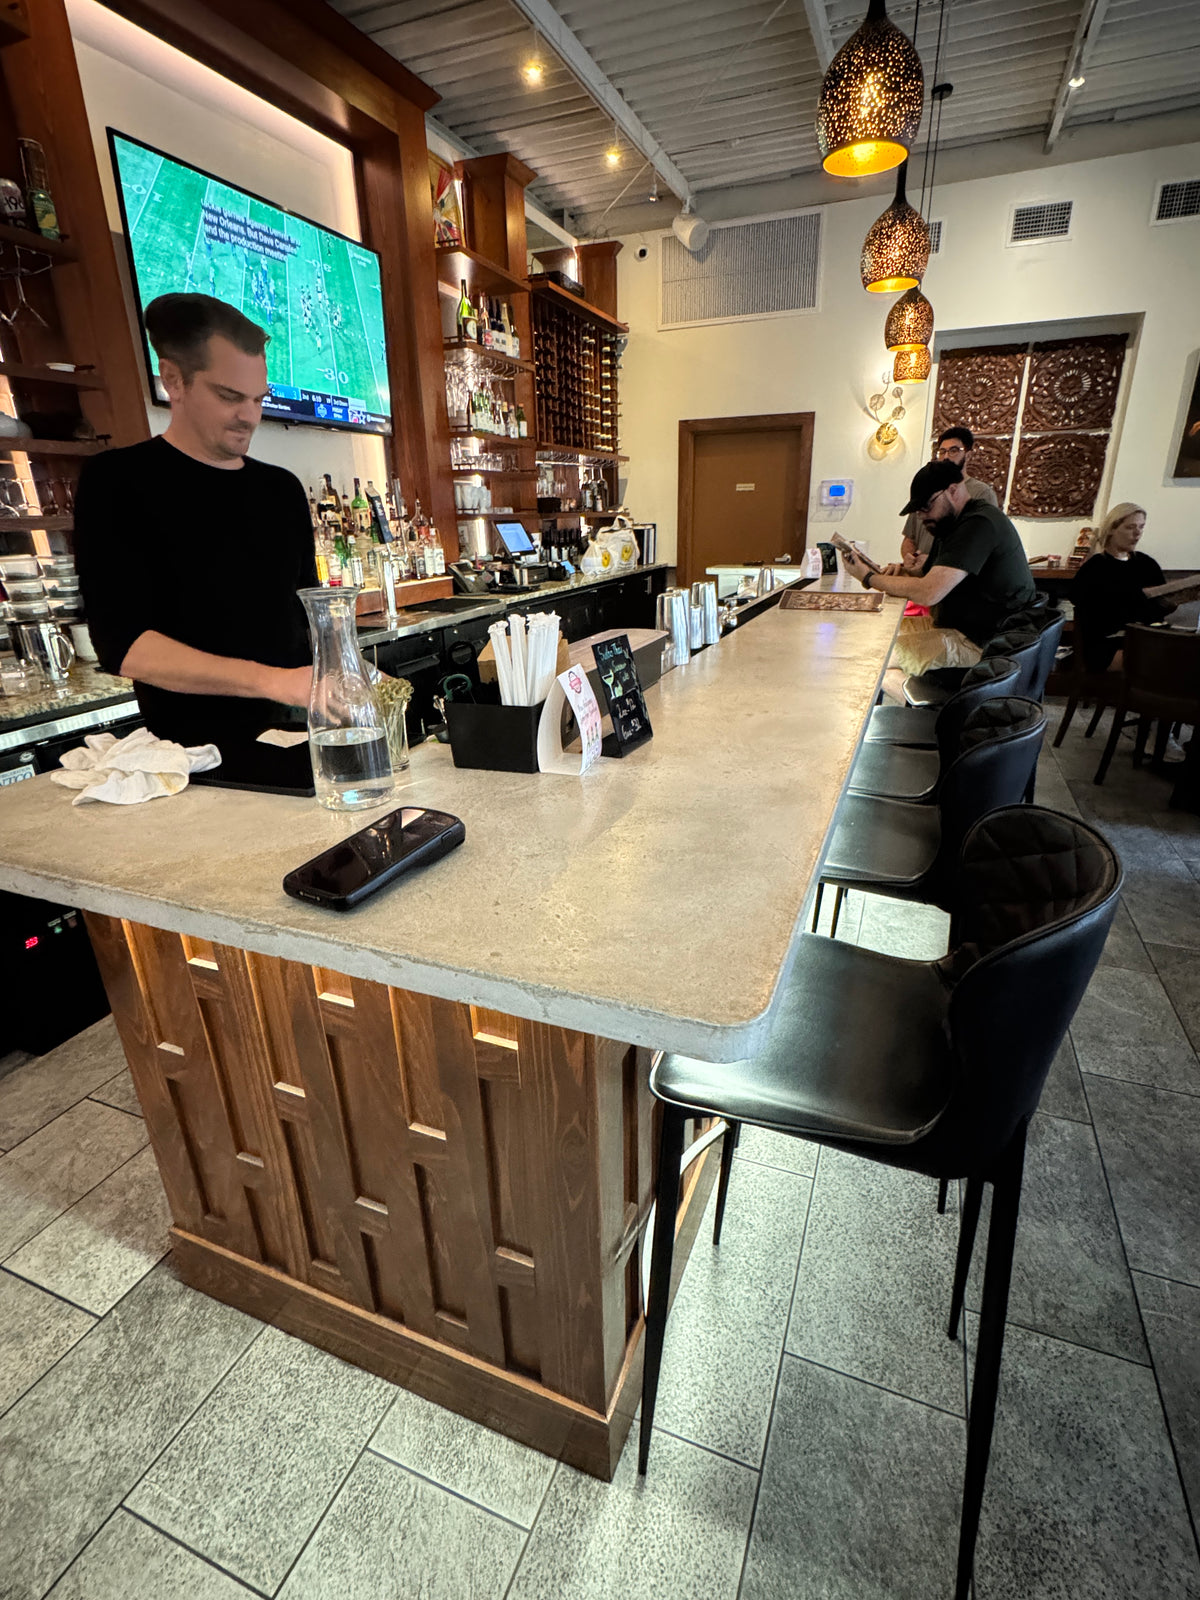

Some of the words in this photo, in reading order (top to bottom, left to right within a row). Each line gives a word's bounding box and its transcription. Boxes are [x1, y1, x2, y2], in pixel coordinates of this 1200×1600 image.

[204, 223, 218, 237] and
[230, 231, 264, 254] production
[205, 210, 218, 225] New
[219, 216, 246, 236] Orleans.
[258, 232, 274, 247] Dave
